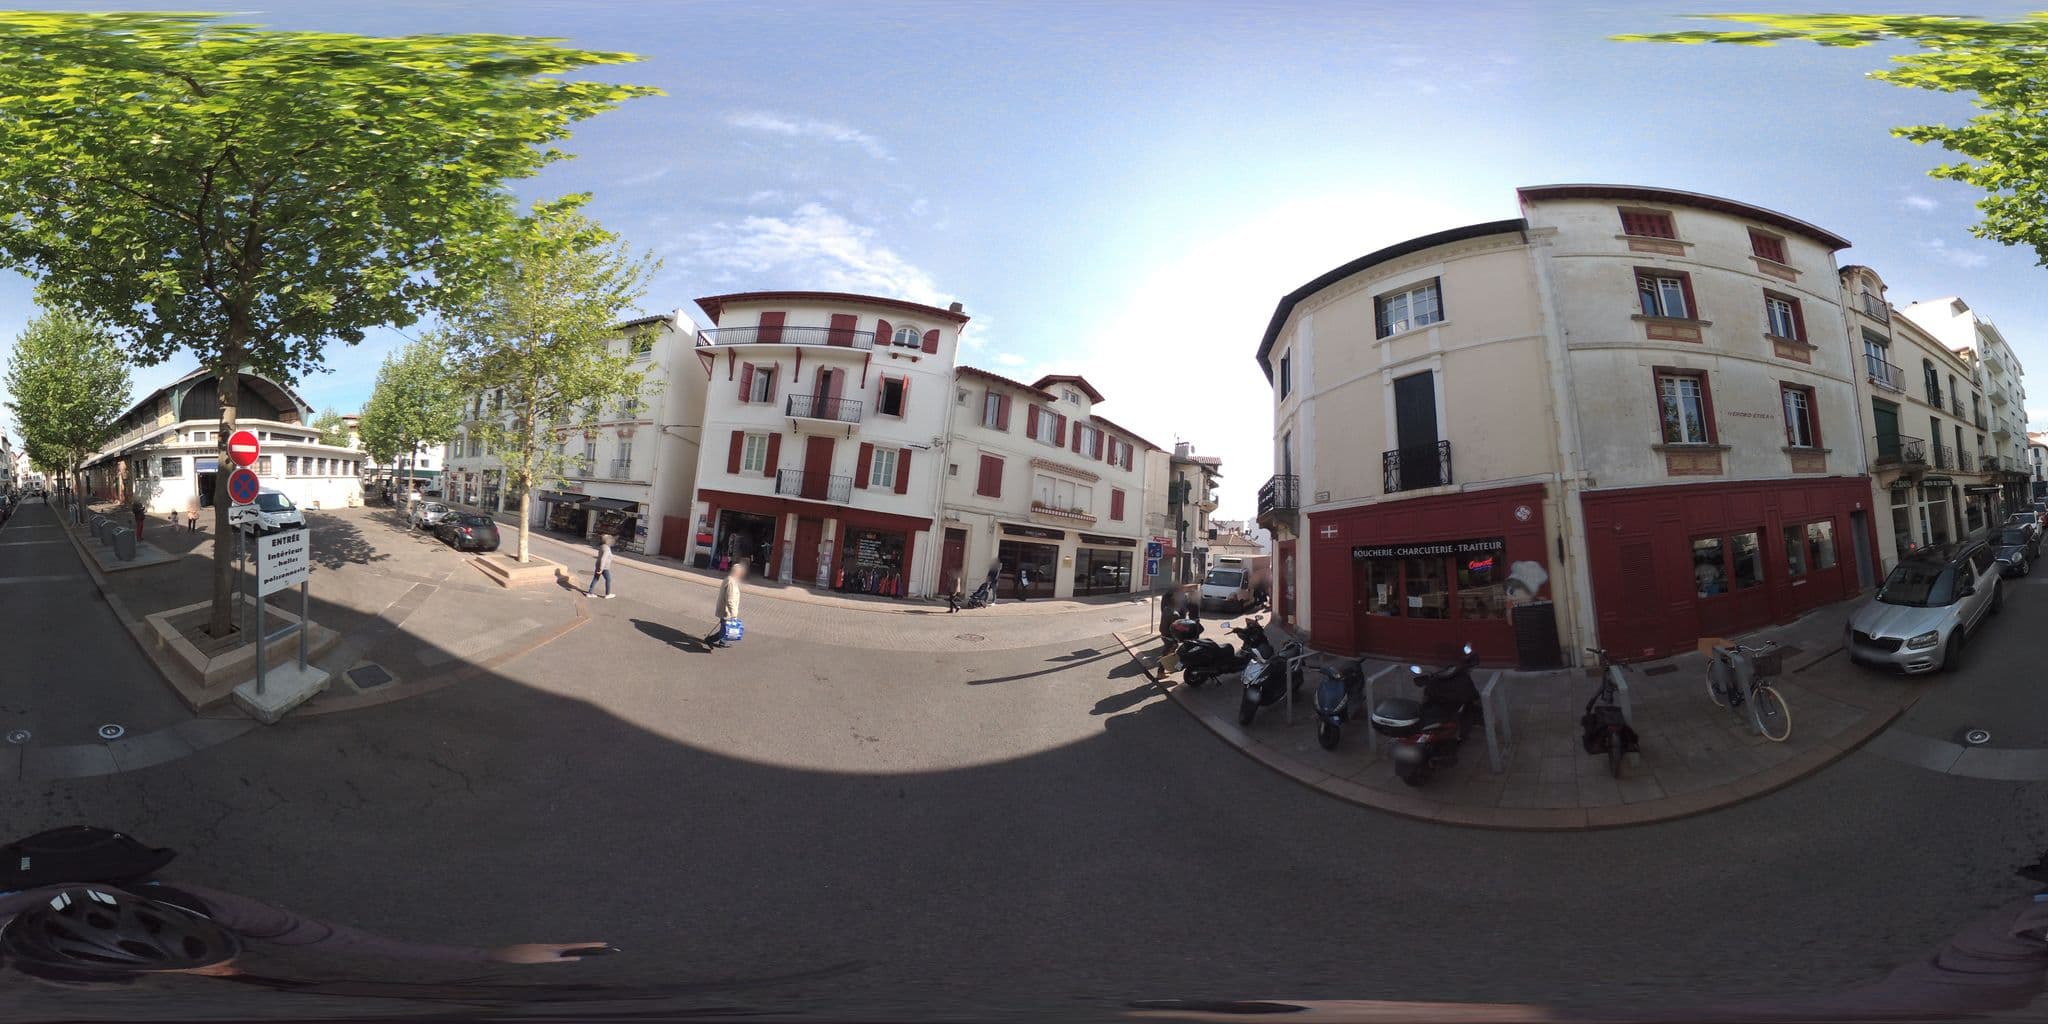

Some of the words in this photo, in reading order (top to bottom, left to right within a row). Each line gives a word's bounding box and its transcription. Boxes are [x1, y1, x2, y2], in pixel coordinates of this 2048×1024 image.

[272, 534, 300, 547] ENTRÉE
[268, 548, 303, 560] Intérieur
[1353, 548, 1393, 558] BOUCHERIE
[1397, 544, 1454, 556] CHARCUTERIE
[1458, 541, 1502, 552] TRAITEUR
